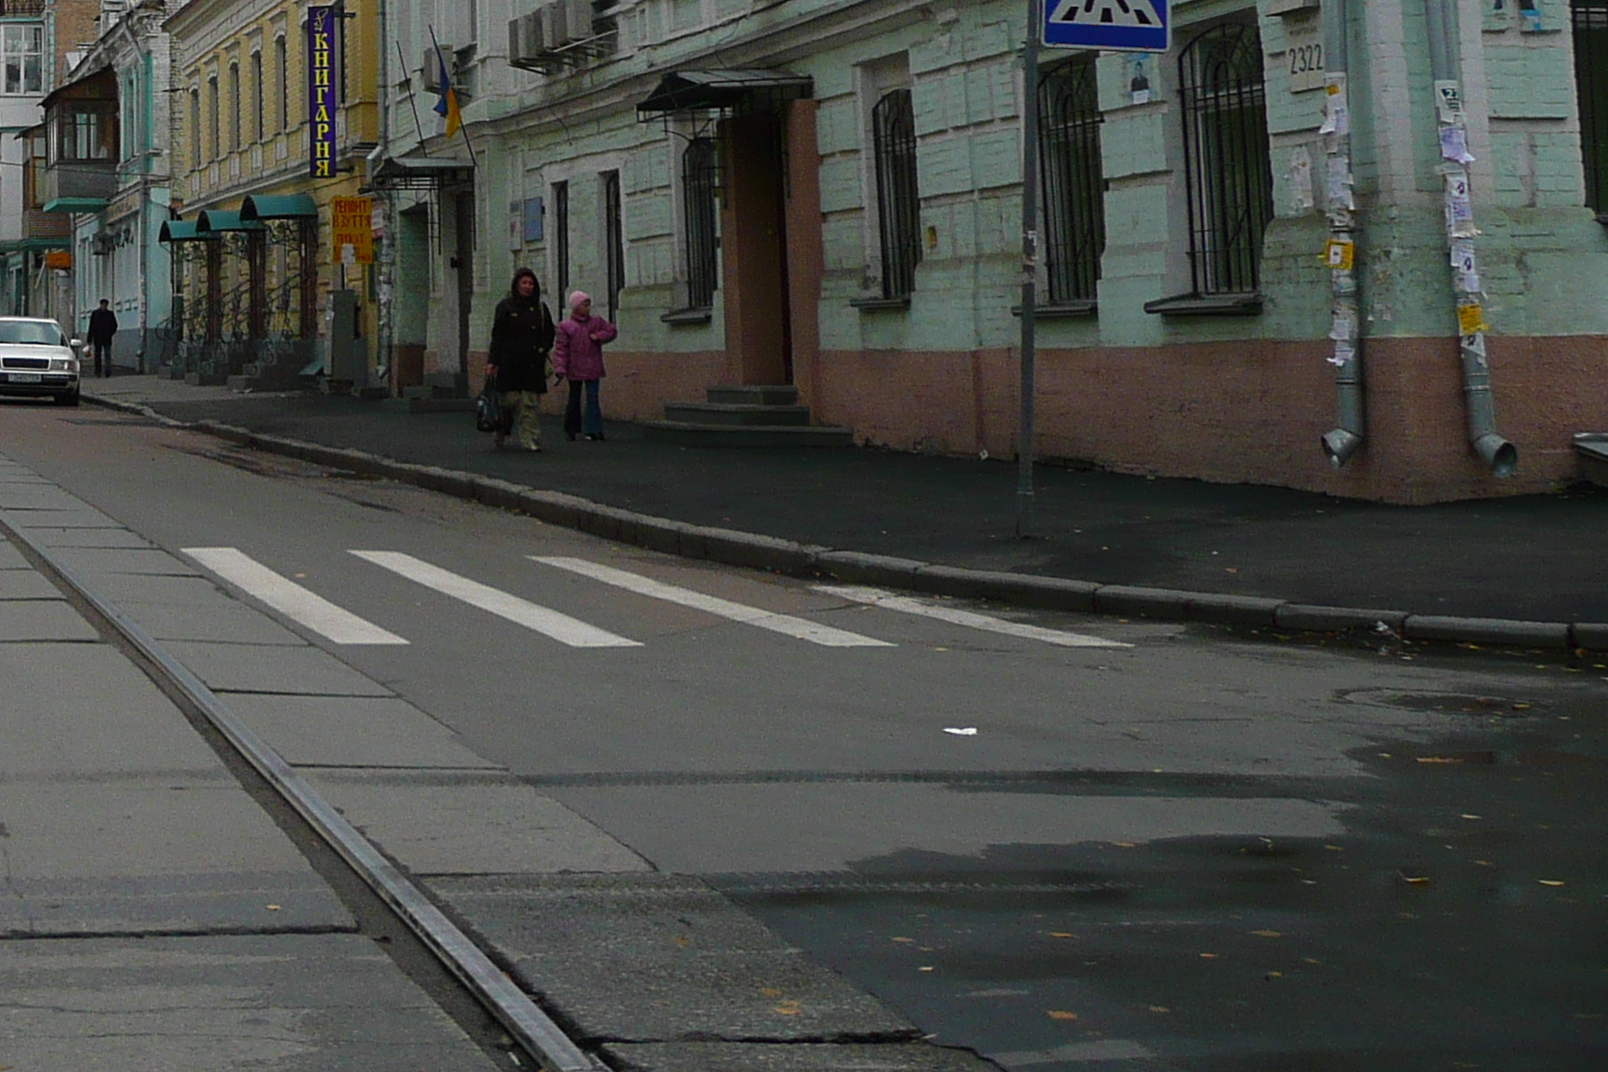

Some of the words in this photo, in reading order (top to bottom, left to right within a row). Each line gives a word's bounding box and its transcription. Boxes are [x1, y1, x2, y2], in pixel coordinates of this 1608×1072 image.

[313, 32, 330, 177] КНИГАРНЯ
[335, 199, 367, 214] РЕМОНТ
[333, 214, 372, 228] ВЗУТТЯ
